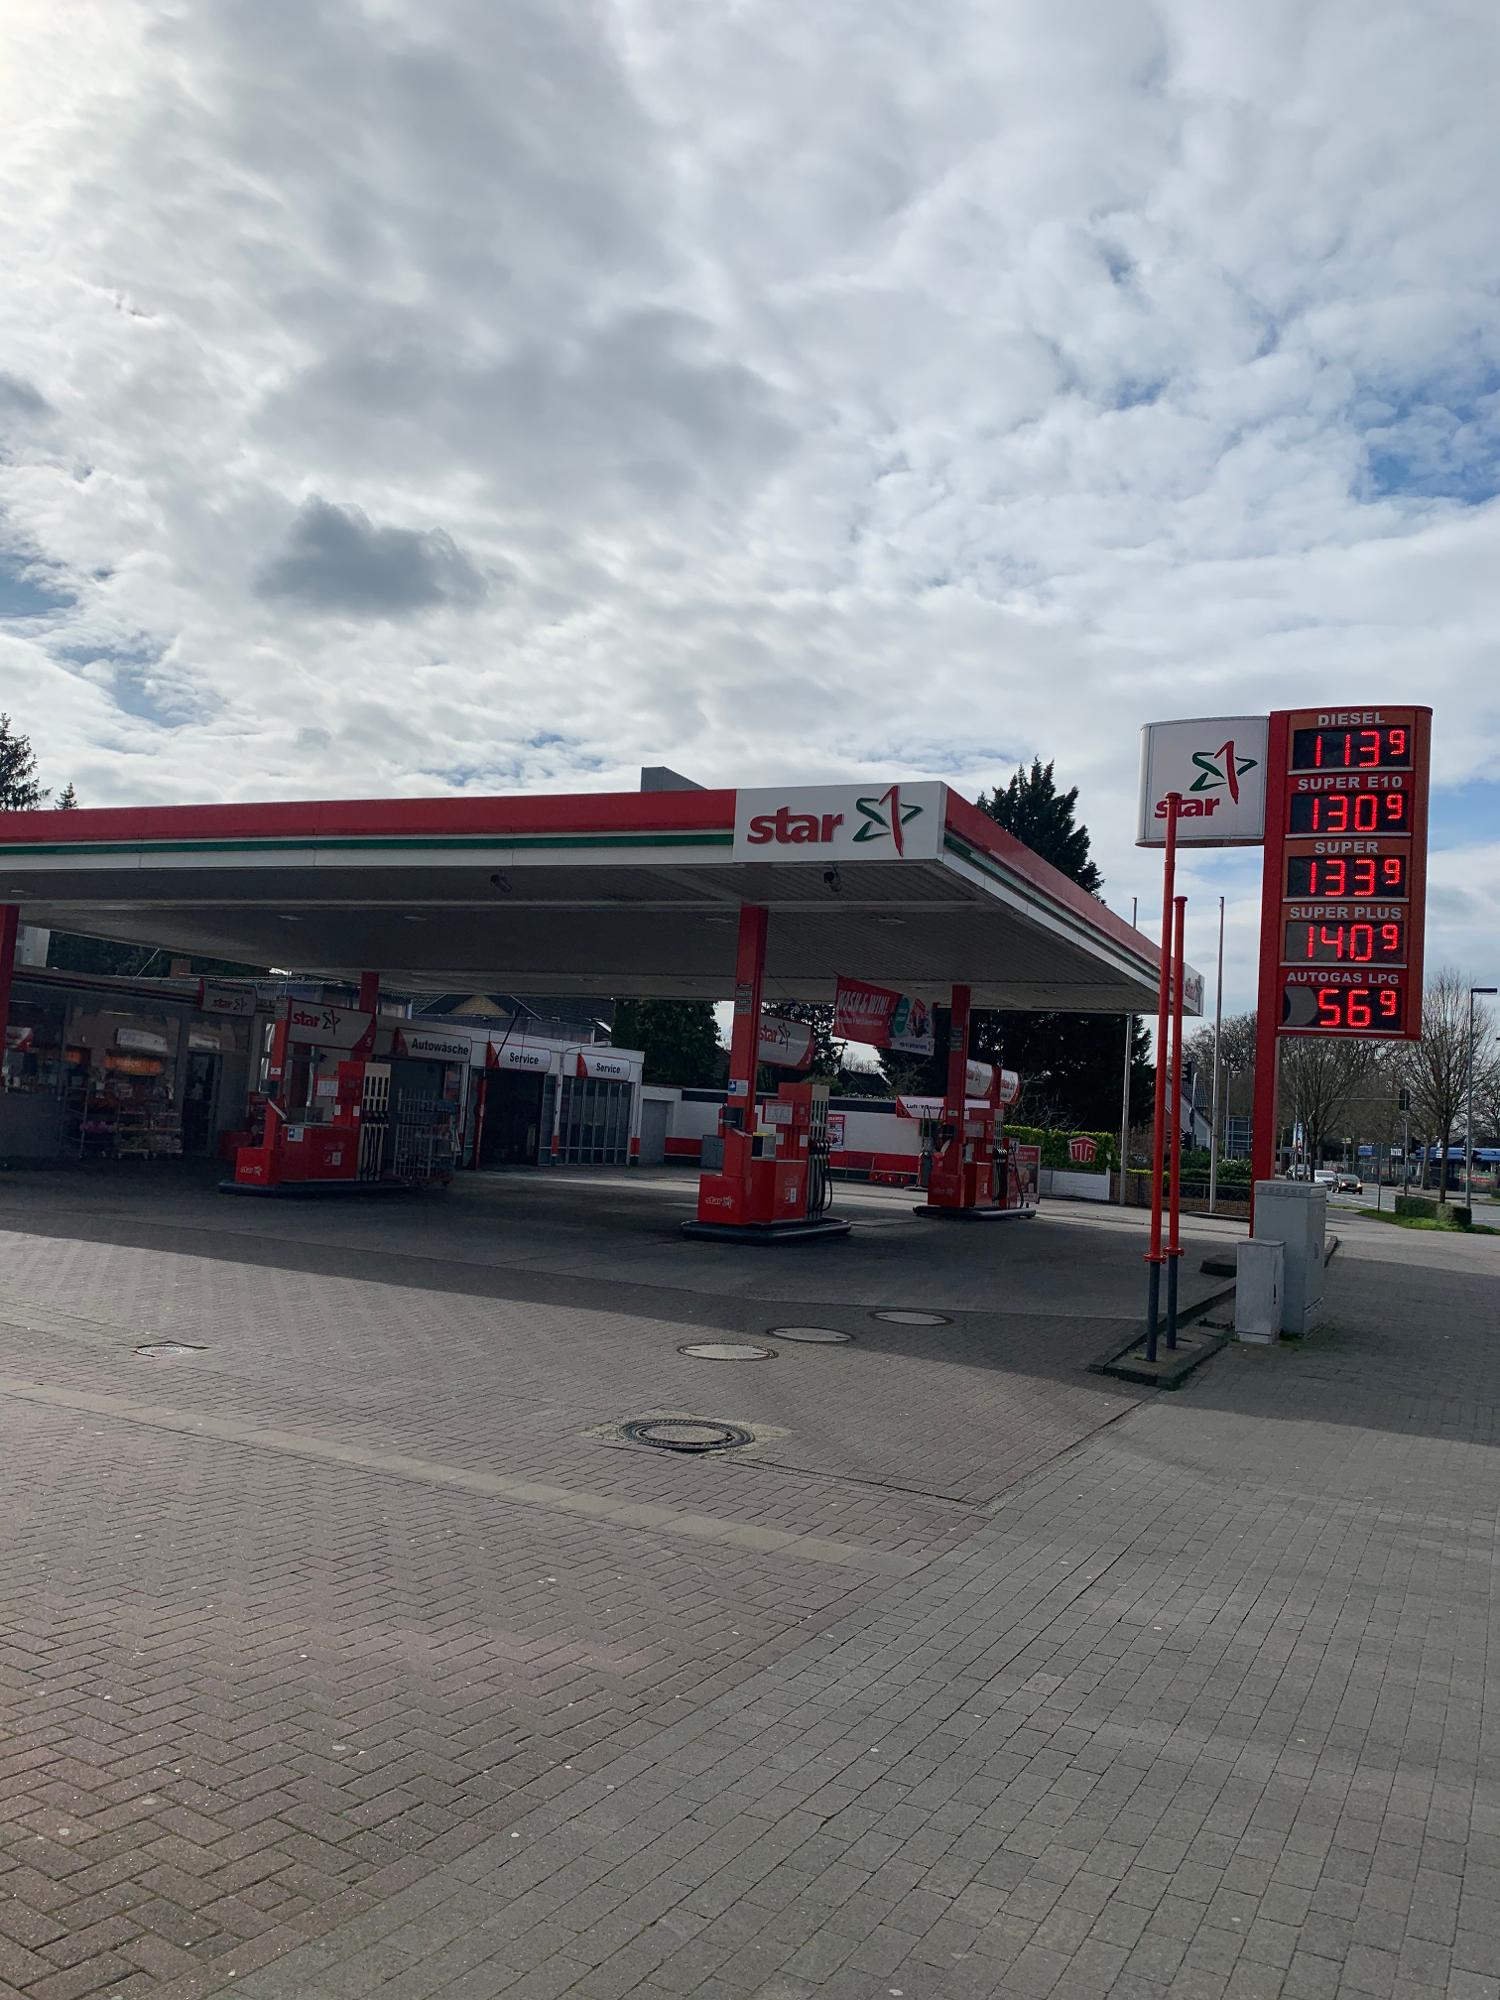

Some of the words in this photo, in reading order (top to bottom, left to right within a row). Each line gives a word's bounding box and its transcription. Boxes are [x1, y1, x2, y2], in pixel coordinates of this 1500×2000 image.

[1318, 712, 1385, 726] DIESEL
[1298, 778, 1363, 790] SUPER
[1368, 776, 1403, 789] E10
[747, 806, 845, 845] star
[1314, 842, 1378, 854] SUPER
[1290, 907, 1350, 919] SUPER
[1354, 907, 1402, 919] PLUS
[1287, 972, 1363, 983] AUTOGAS
[1368, 973, 1400, 985] LPG
[292, 1010, 320, 1027] star
[411, 1037, 469, 1056] Autowäsche
[509, 1051, 539, 1065] Service
[595, 1062, 621, 1074] Service
[1070, 1143, 1096, 1163] UTA
